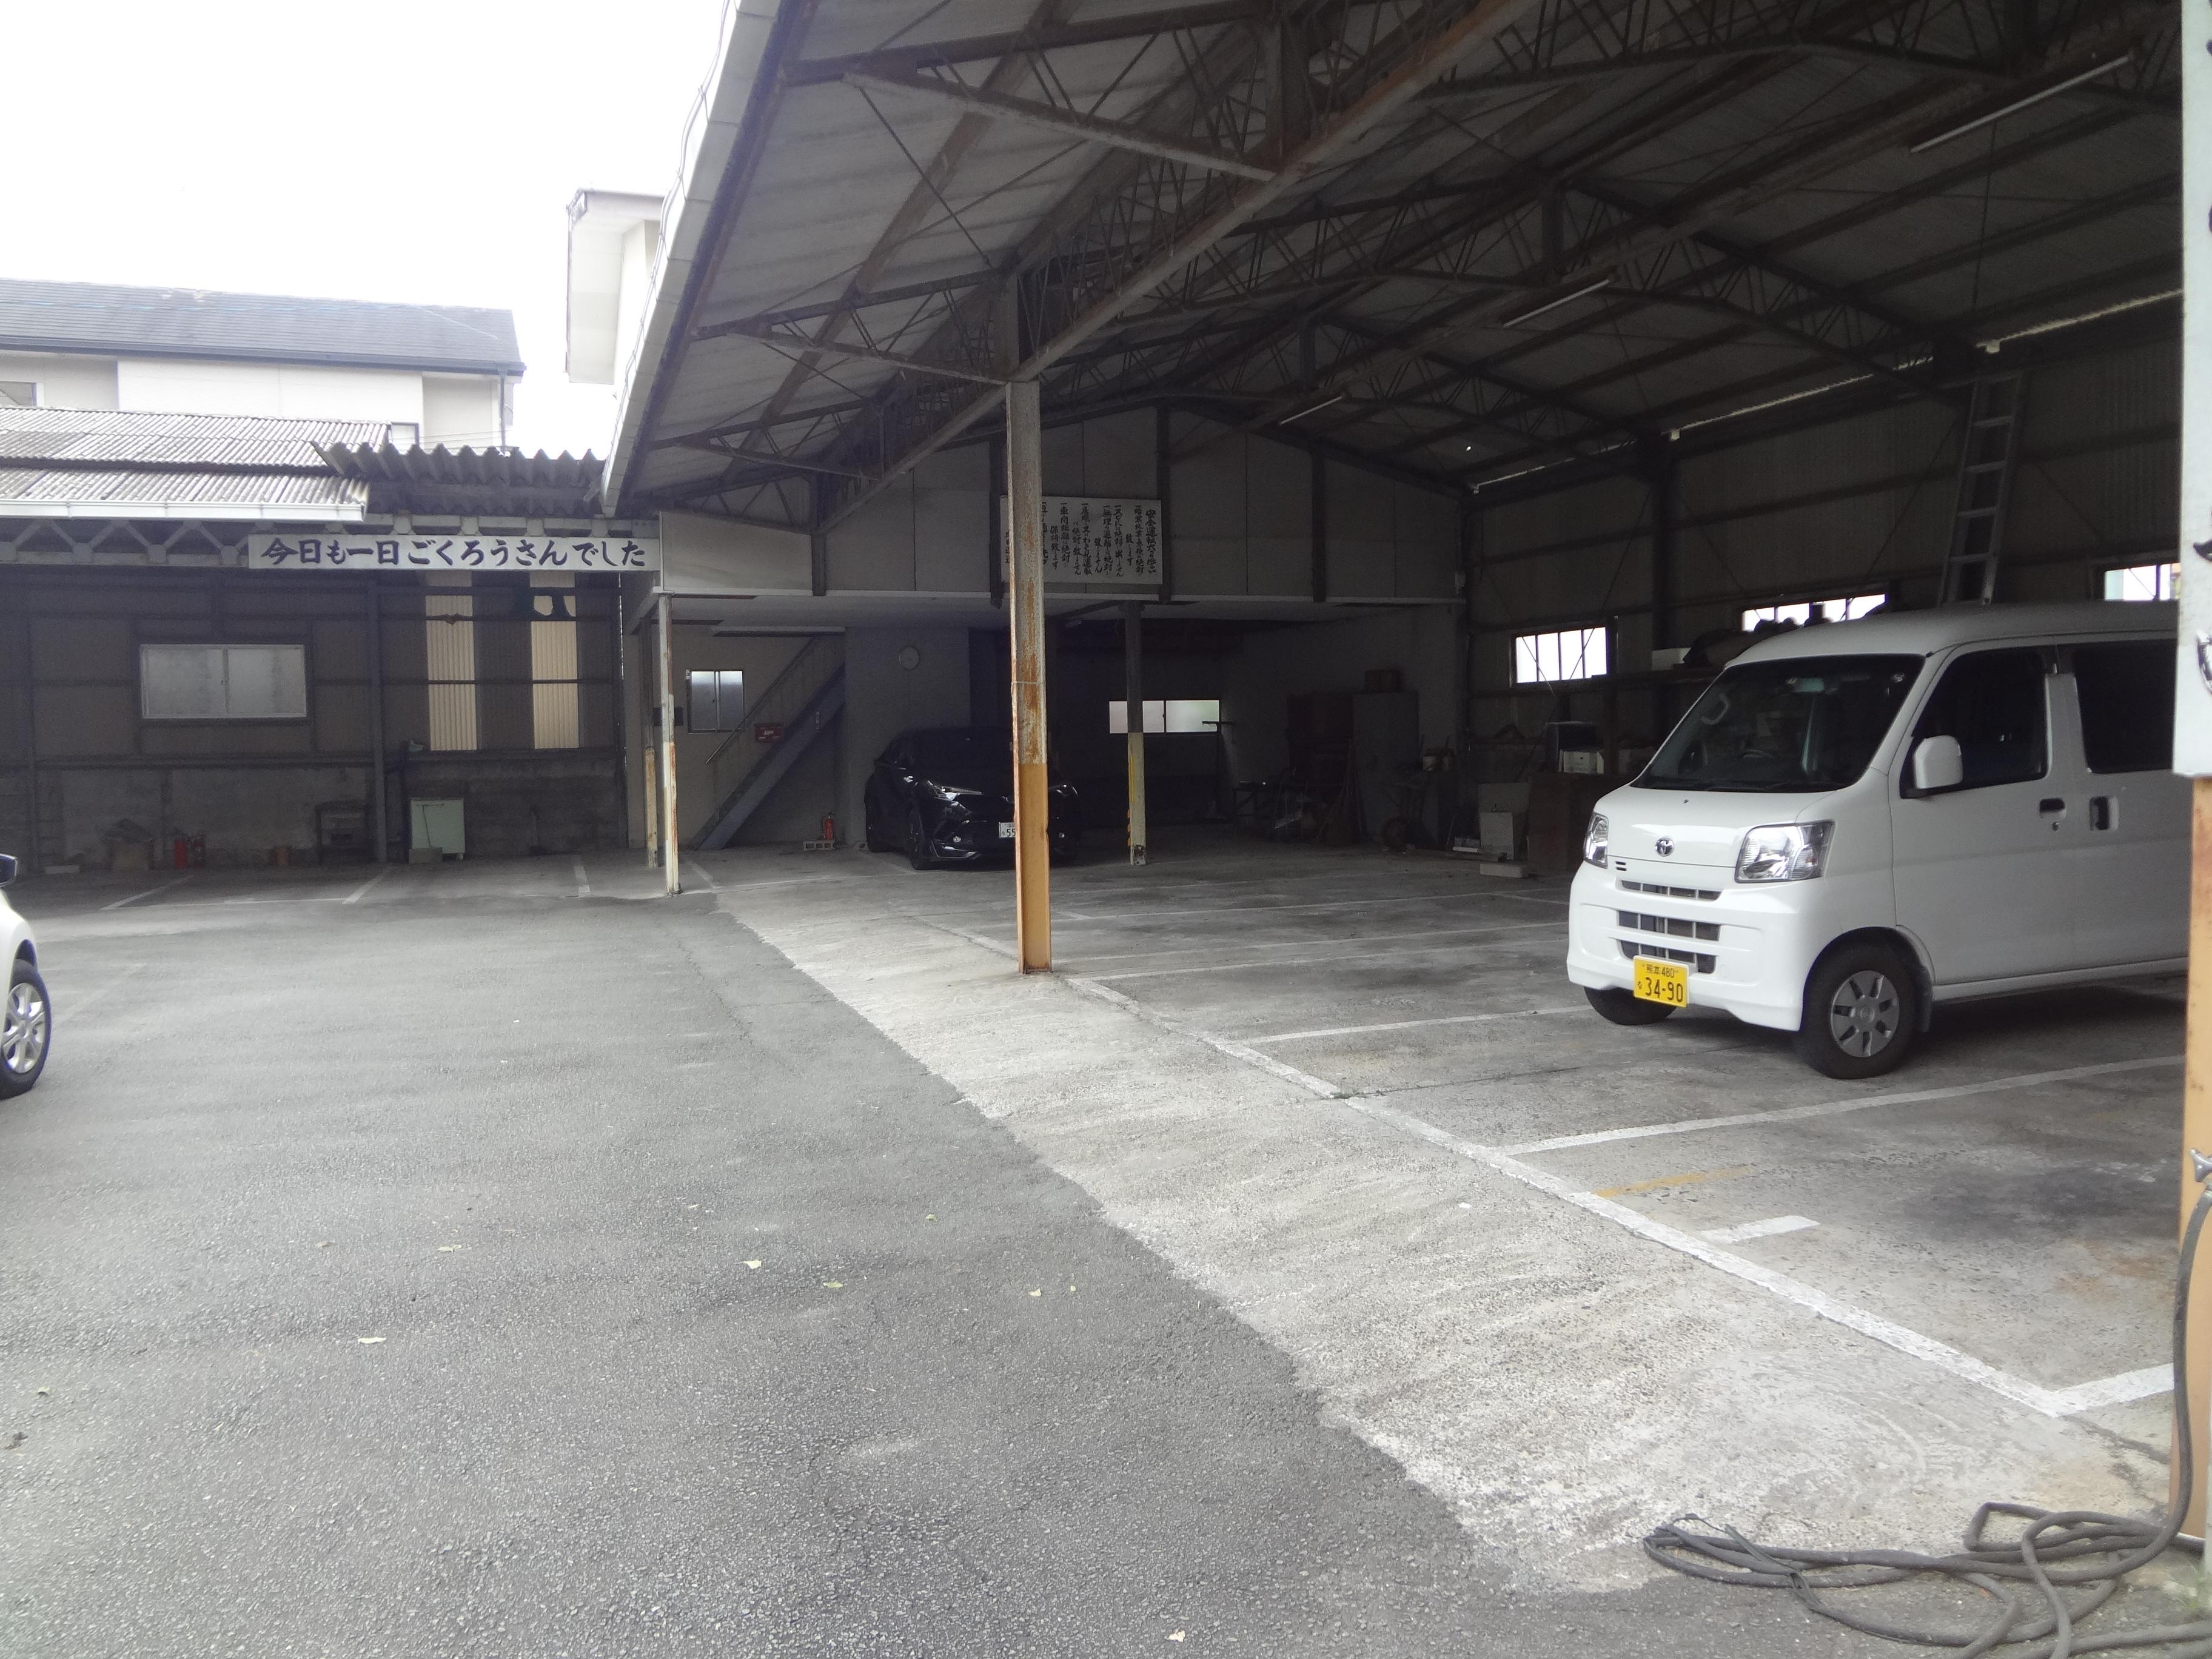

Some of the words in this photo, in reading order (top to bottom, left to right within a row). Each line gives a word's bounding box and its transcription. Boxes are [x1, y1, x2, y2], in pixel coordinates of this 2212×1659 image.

[261, 537, 647, 567] 今日も一日ごくろうさんでした
[1645, 977, 1684, 1002] 34-90
